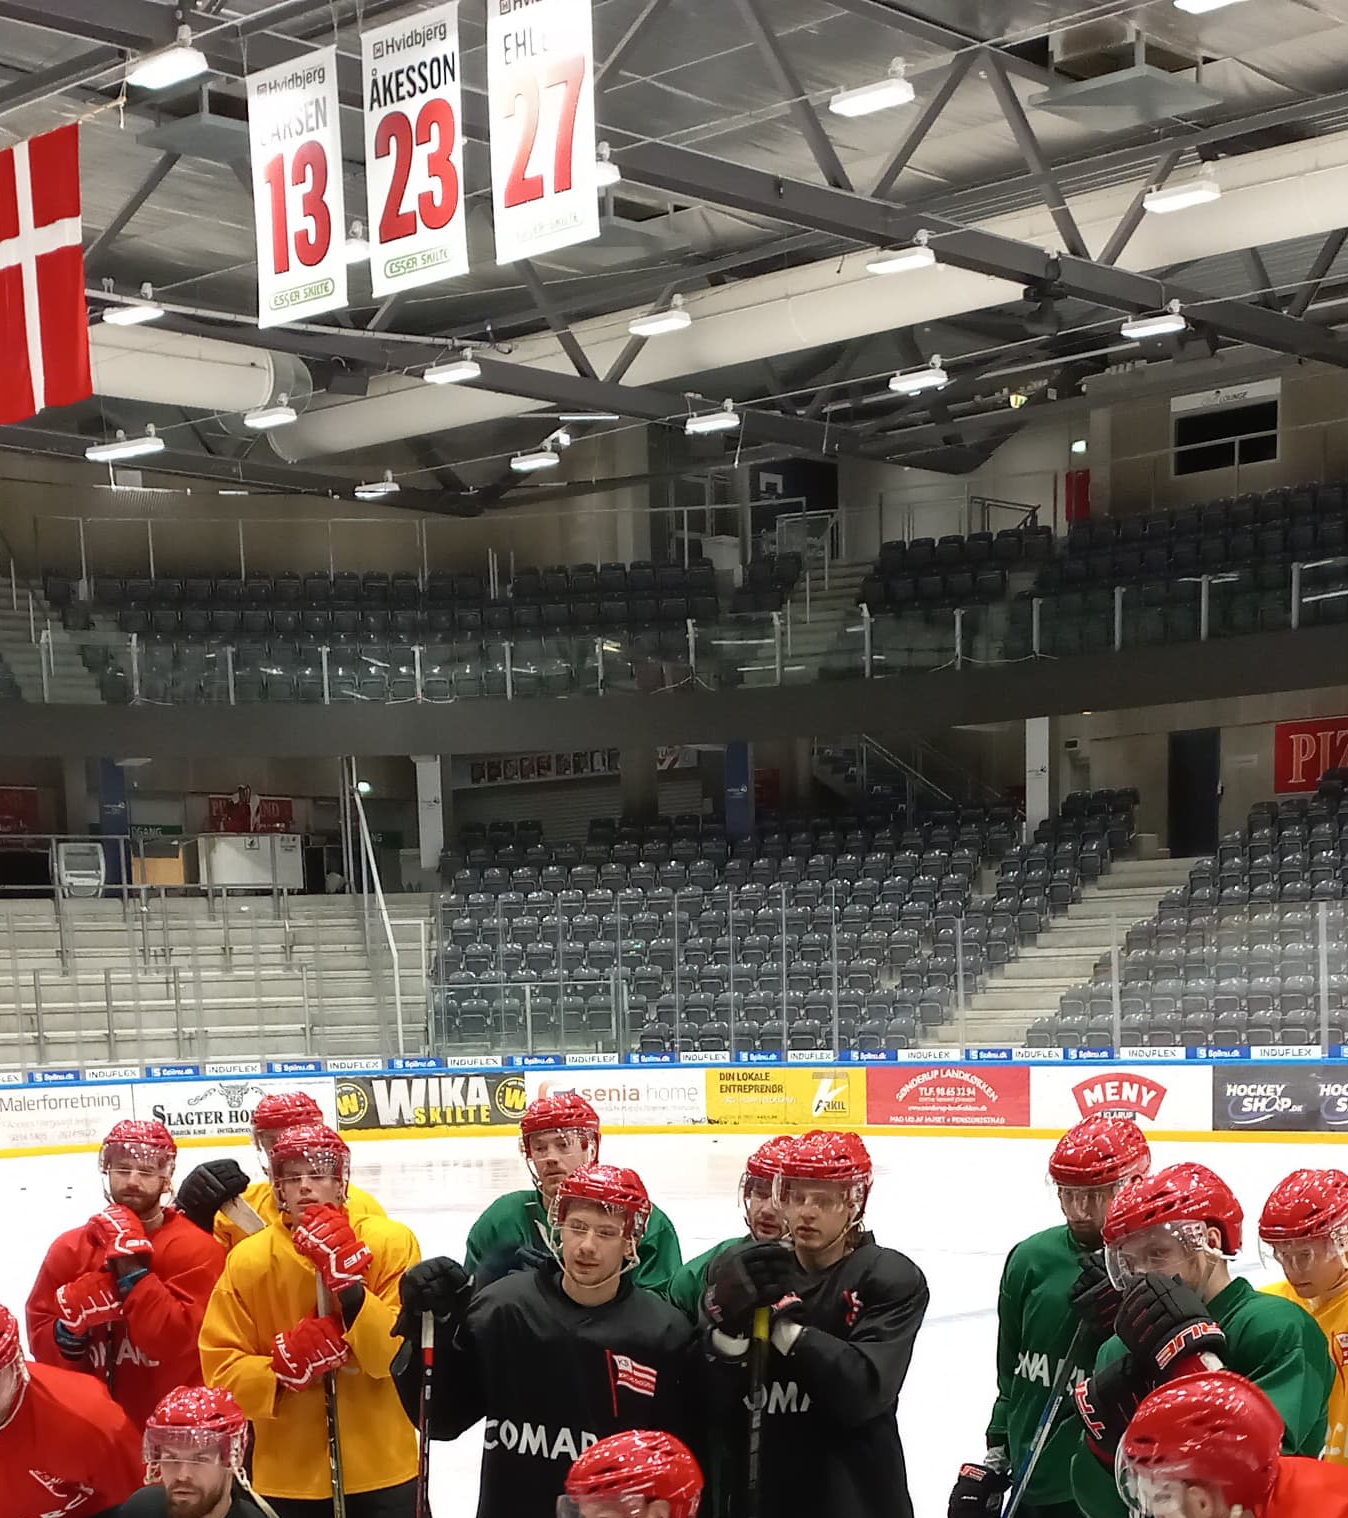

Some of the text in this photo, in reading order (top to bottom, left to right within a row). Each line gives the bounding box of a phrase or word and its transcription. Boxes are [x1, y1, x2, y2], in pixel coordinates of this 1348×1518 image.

[384, 22, 448, 56] Hvidbjerg
[268, 66, 326, 92] Hvidbjerg
[368, 51, 457, 112] ÅKESSON
[502, 55, 587, 209] 27
[374, 98, 459, 244] 23
[265, 140, 332, 275] 13
[567, 1053, 617, 1065] INDUFLEX
[681, 1051, 728, 1063] INDUFLEX
[790, 1051, 832, 1062] INDUFLEX
[907, 1051, 950, 1060] INDUFLEX
[1015, 1050, 1061, 1060] INDUFLEX
[1128, 1048, 1176, 1059] INDUFLEX
[1259, 1047, 1312, 1058] INDUFLEX
[328, 1059, 379, 1071] INDUFLEX
[449, 1055, 500, 1067] INDUFLEX
[87, 1067, 138, 1079] INDUFLEX
[208, 1063, 259, 1075] INDUFLEX
[719, 1071, 771, 1082] DIN LOKALE
[581, 1084, 640, 1102] senia
[646, 1084, 699, 1102] home
[719, 1084, 784, 1094] ENTREPRENØR
[1081, 1080, 1159, 1109] MENY
[1226, 1082, 1286, 1098] HOCKEY
[0, 1092, 122, 1113] Malerforretning
[371, 1076, 490, 1127] WIKA
[814, 1099, 846, 1112] ARKIL
[152, 1104, 225, 1127] SLAGTER
[413, 1104, 491, 1126] SKILTE
